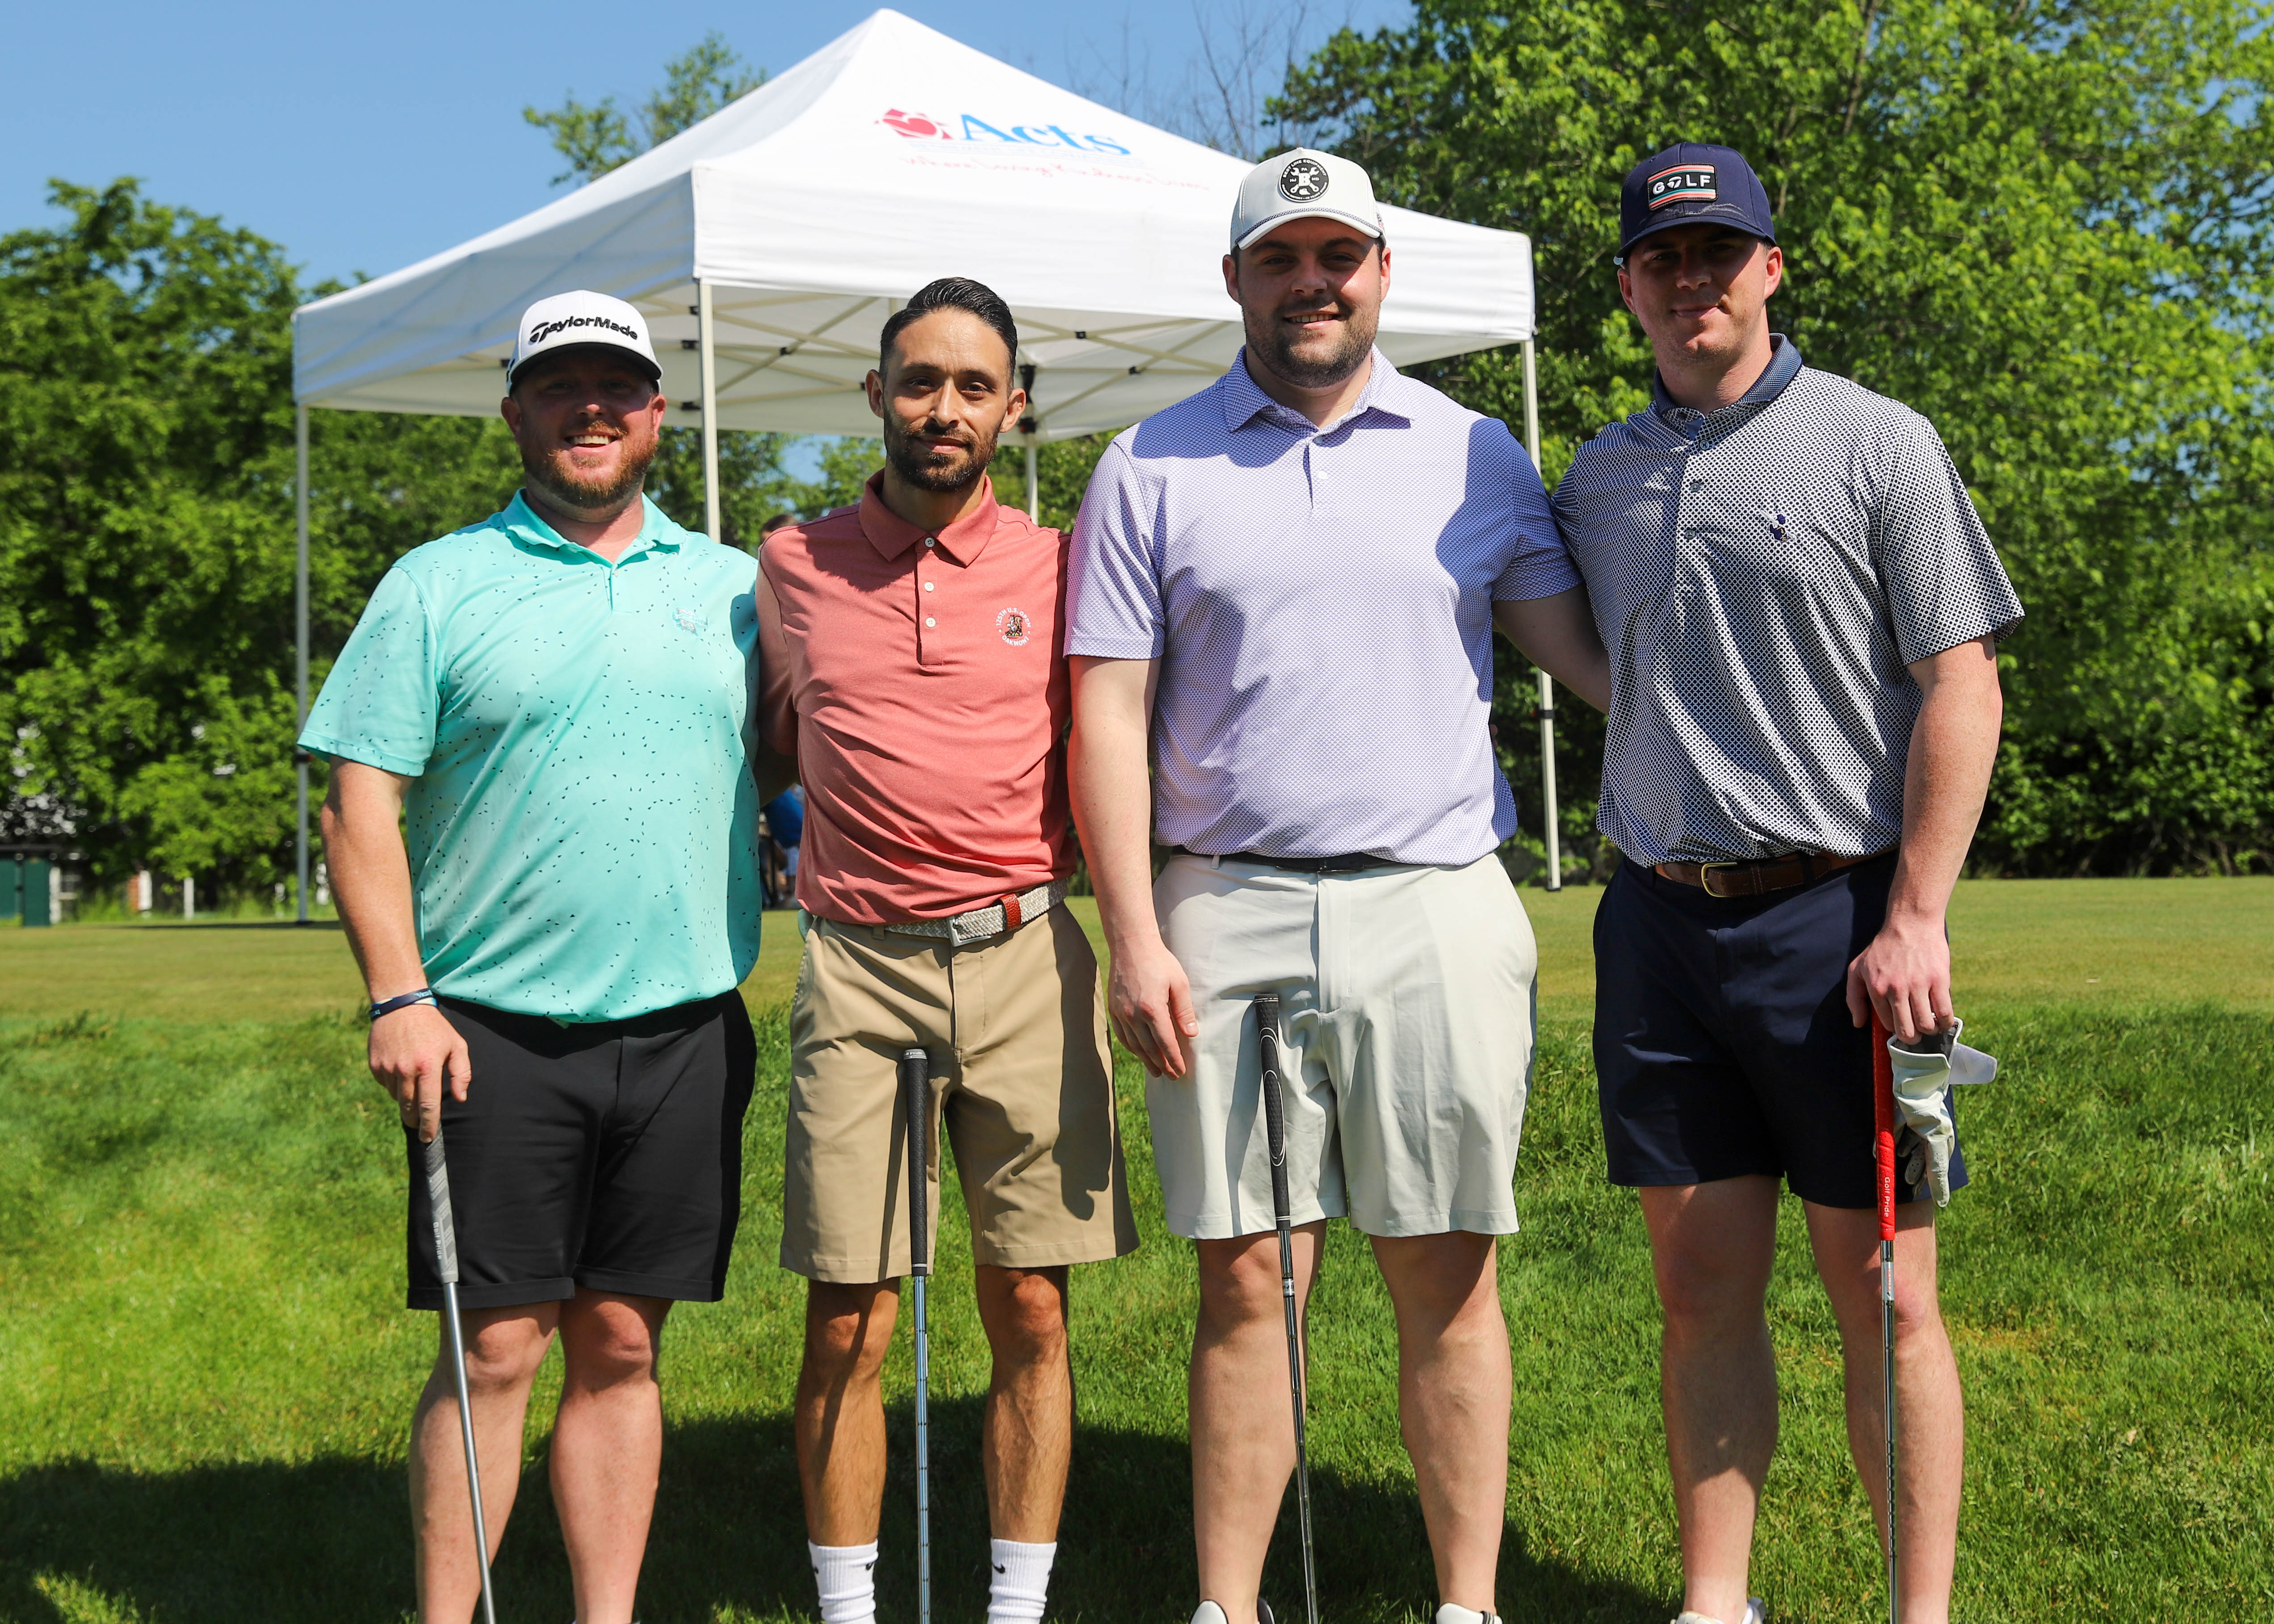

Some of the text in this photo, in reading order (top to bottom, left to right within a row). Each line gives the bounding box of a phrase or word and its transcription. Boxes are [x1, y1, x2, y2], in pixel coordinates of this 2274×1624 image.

[960, 113, 1132, 155] Acts
[1283, 165, 1291, 178] BEST
[1303, 159, 1326, 176] EQUIPMENT
[1298, 173, 1311, 187] B
[529, 316, 638, 343] TaylorMade
[996, 609, 1007, 625] 125TH
[1019, 611, 1031, 627] OPEN
[1002, 635, 1030, 646] OAKMONT
